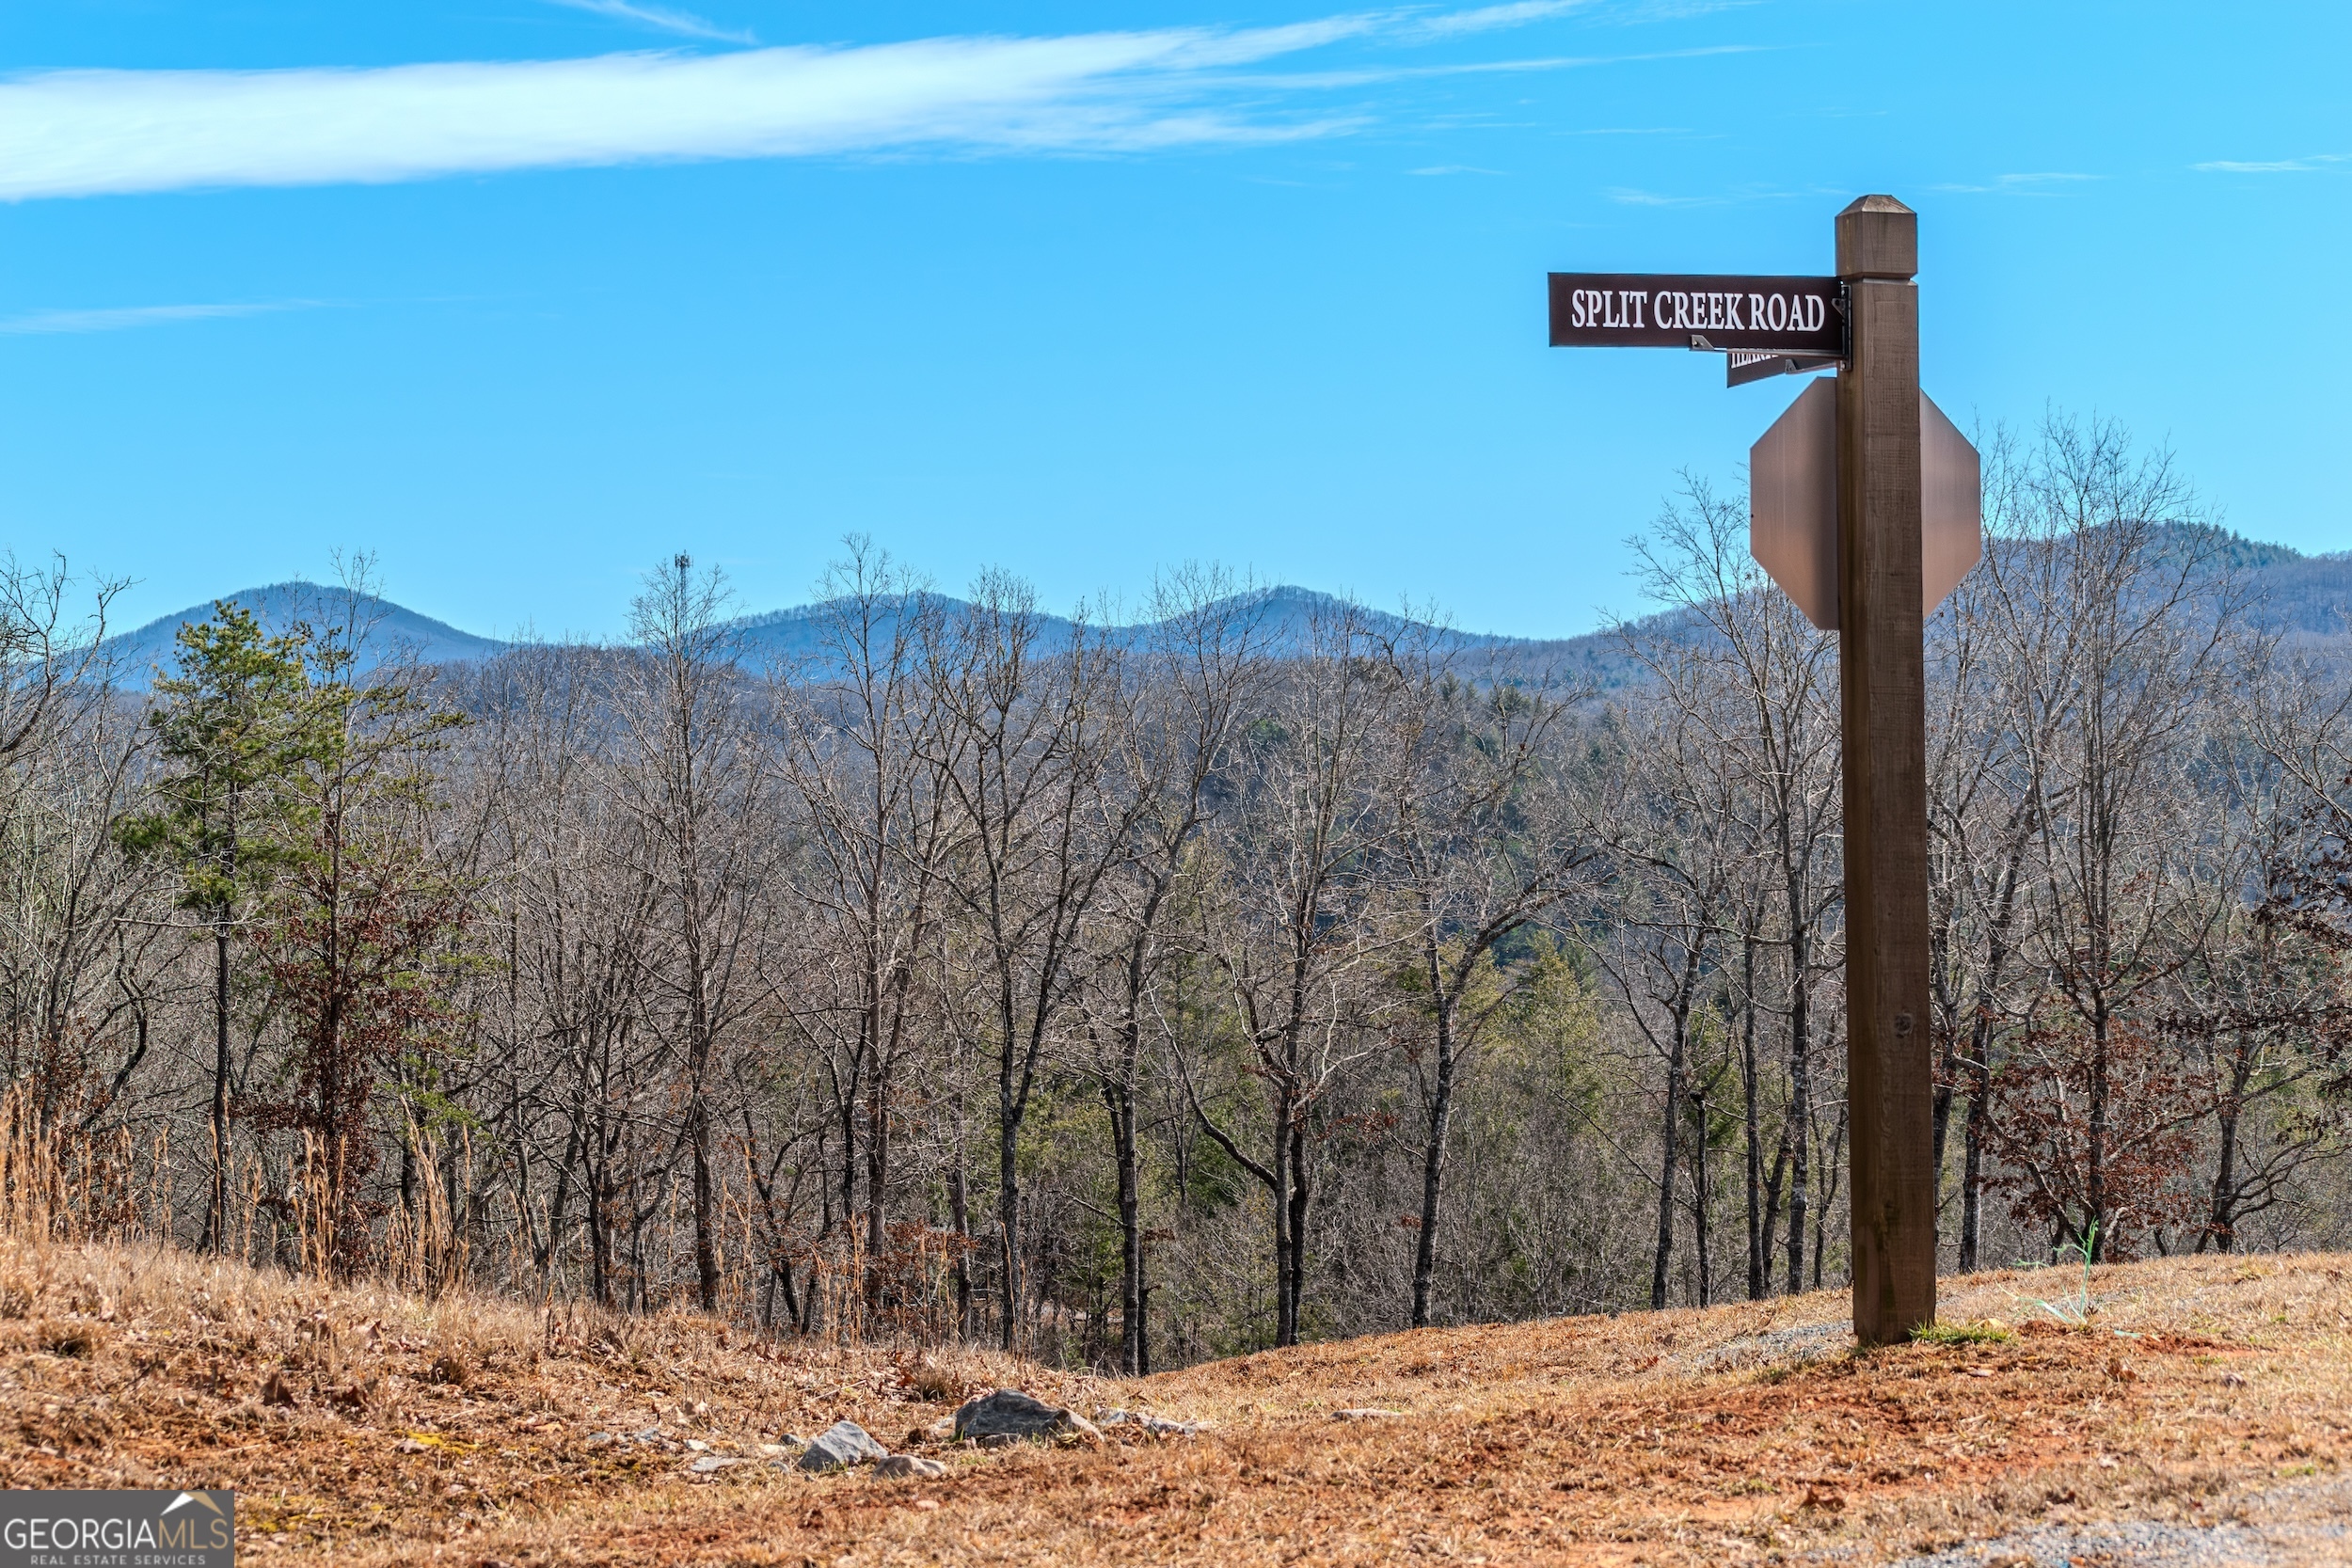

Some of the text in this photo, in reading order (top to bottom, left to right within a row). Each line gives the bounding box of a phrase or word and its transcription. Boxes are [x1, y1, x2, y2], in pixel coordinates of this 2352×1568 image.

[1571, 289, 1825, 332] SPLIT CREEK ROAD
